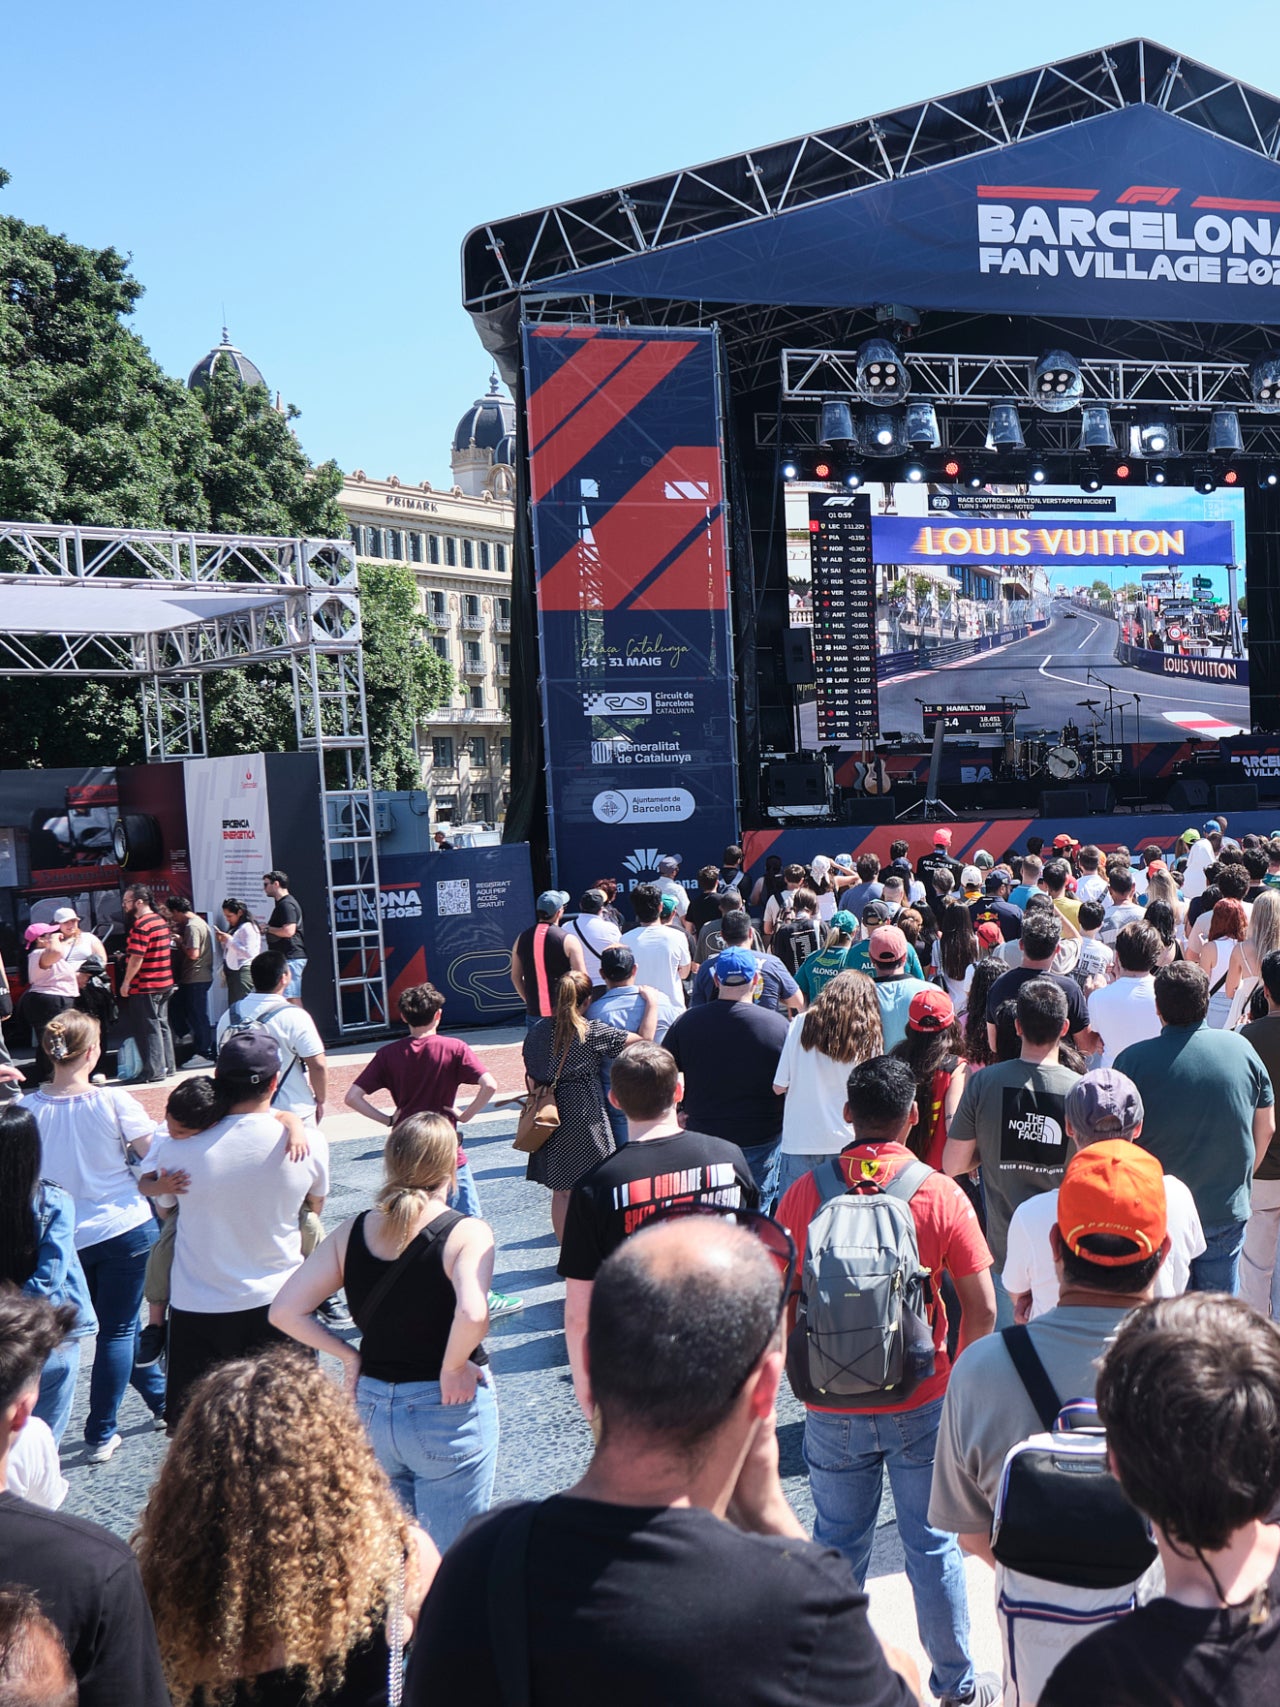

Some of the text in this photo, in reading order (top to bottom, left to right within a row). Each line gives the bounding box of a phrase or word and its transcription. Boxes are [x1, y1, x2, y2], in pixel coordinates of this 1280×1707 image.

[979, 247, 1059, 277] FAN
[1064, 249, 1222, 283] VILLAGE
[386, 495, 438, 513] PRIMARK
[934, 498, 949, 507] FIA
[924, 527, 1185, 556] LOUIS VUITTON
[626, 633, 691, 668] Catalunya
[581, 657, 662, 667] 24 31 MAIG
[1164, 657, 1237, 679] LOUIS VUITTON
[617, 741, 680, 752] Generalitat
[617, 753, 692, 764] de Catalunya
[632, 796, 671, 805] Ajuntament
[632, 804, 681, 813] Barcelona
[387, 906, 422, 918] 2025
[812, 967, 839, 976] ALONSO
[1026, 1112, 1045, 1124] THE
[1008, 1119, 1044, 1135] NORTH
[1018, 1130, 1042, 1143] FACE
